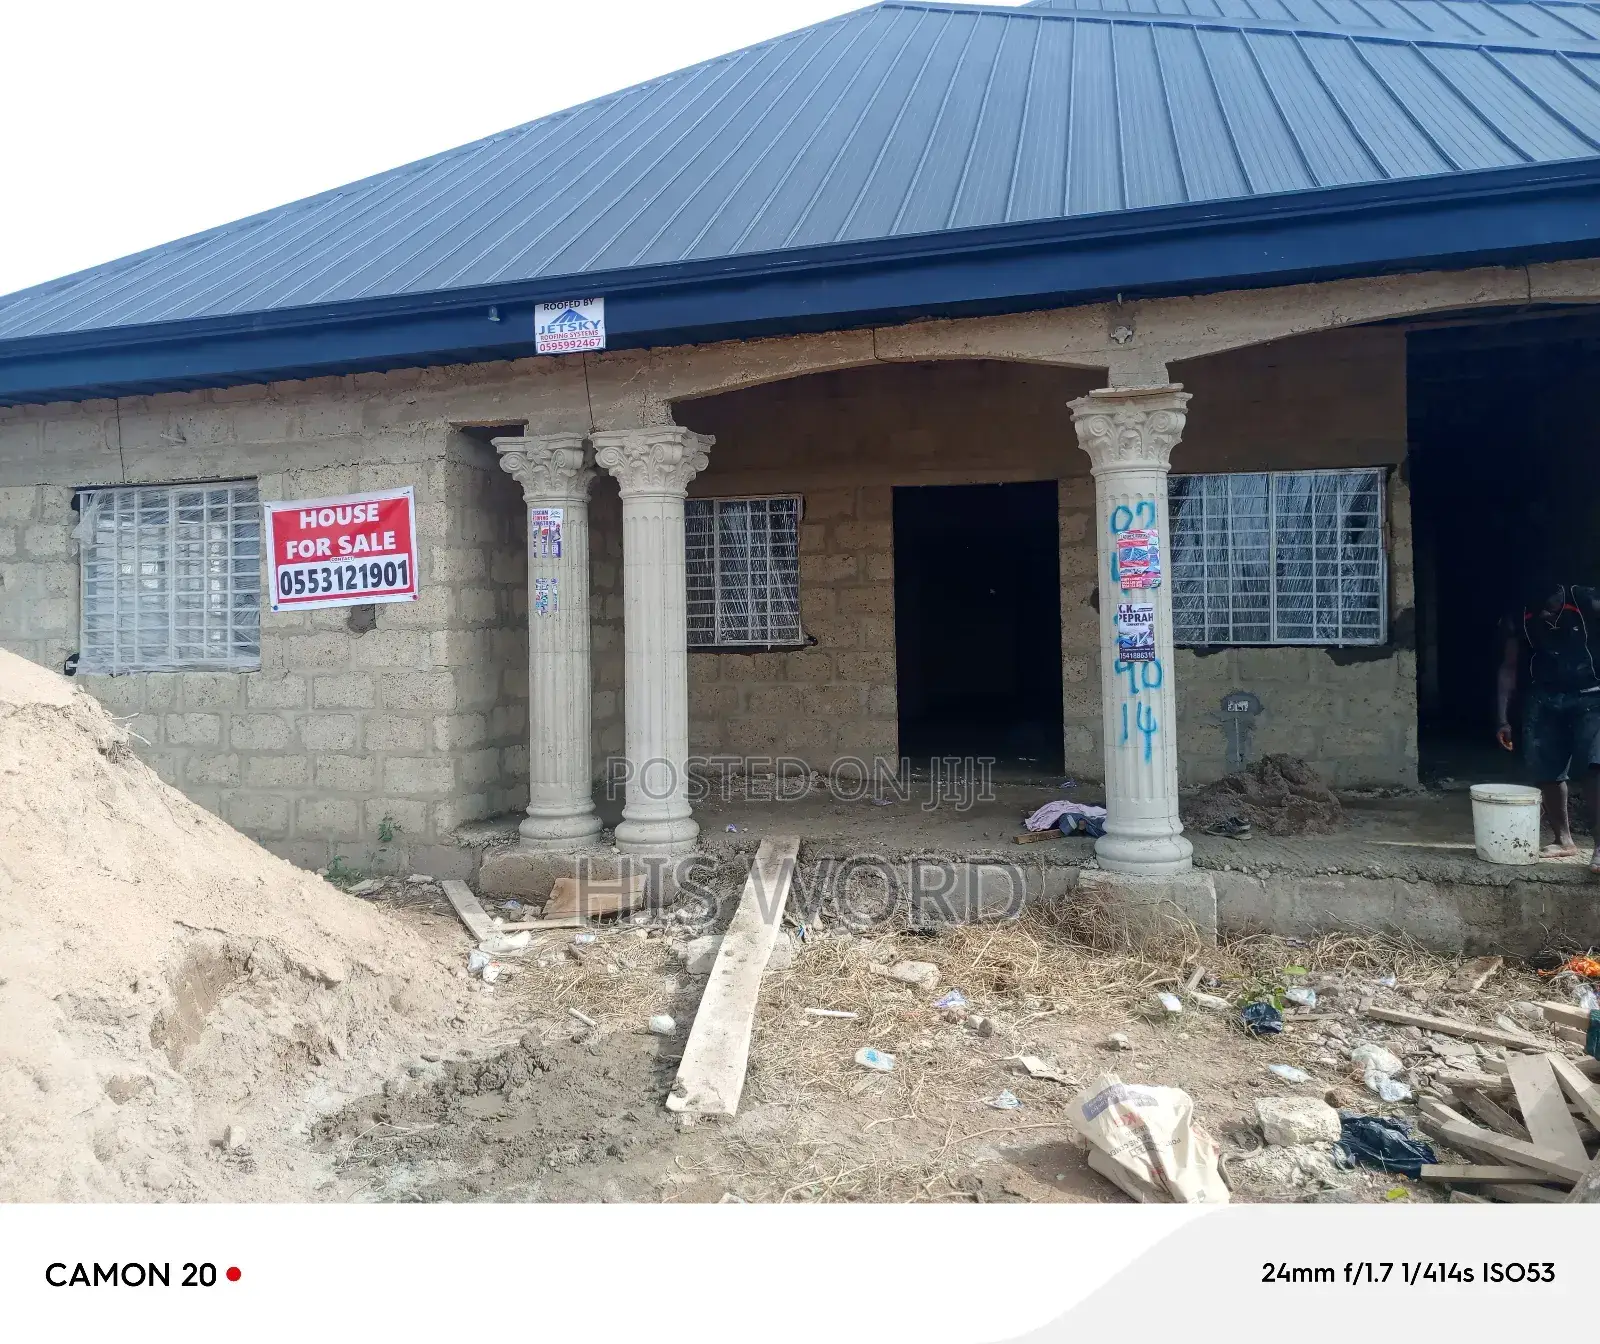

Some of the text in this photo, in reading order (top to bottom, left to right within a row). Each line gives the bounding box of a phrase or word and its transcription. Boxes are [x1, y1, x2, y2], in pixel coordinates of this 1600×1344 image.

[543, 298, 595, 311] ROOFED BY
[539, 320, 602, 335] JETSKY
[540, 329, 599, 341] ROOFING SYSTEMS
[540, 338, 601, 352] 0595992467
[300, 503, 380, 530] HOUSE
[286, 530, 397, 560] FOR SALE
[280, 559, 408, 596] 0553121901
